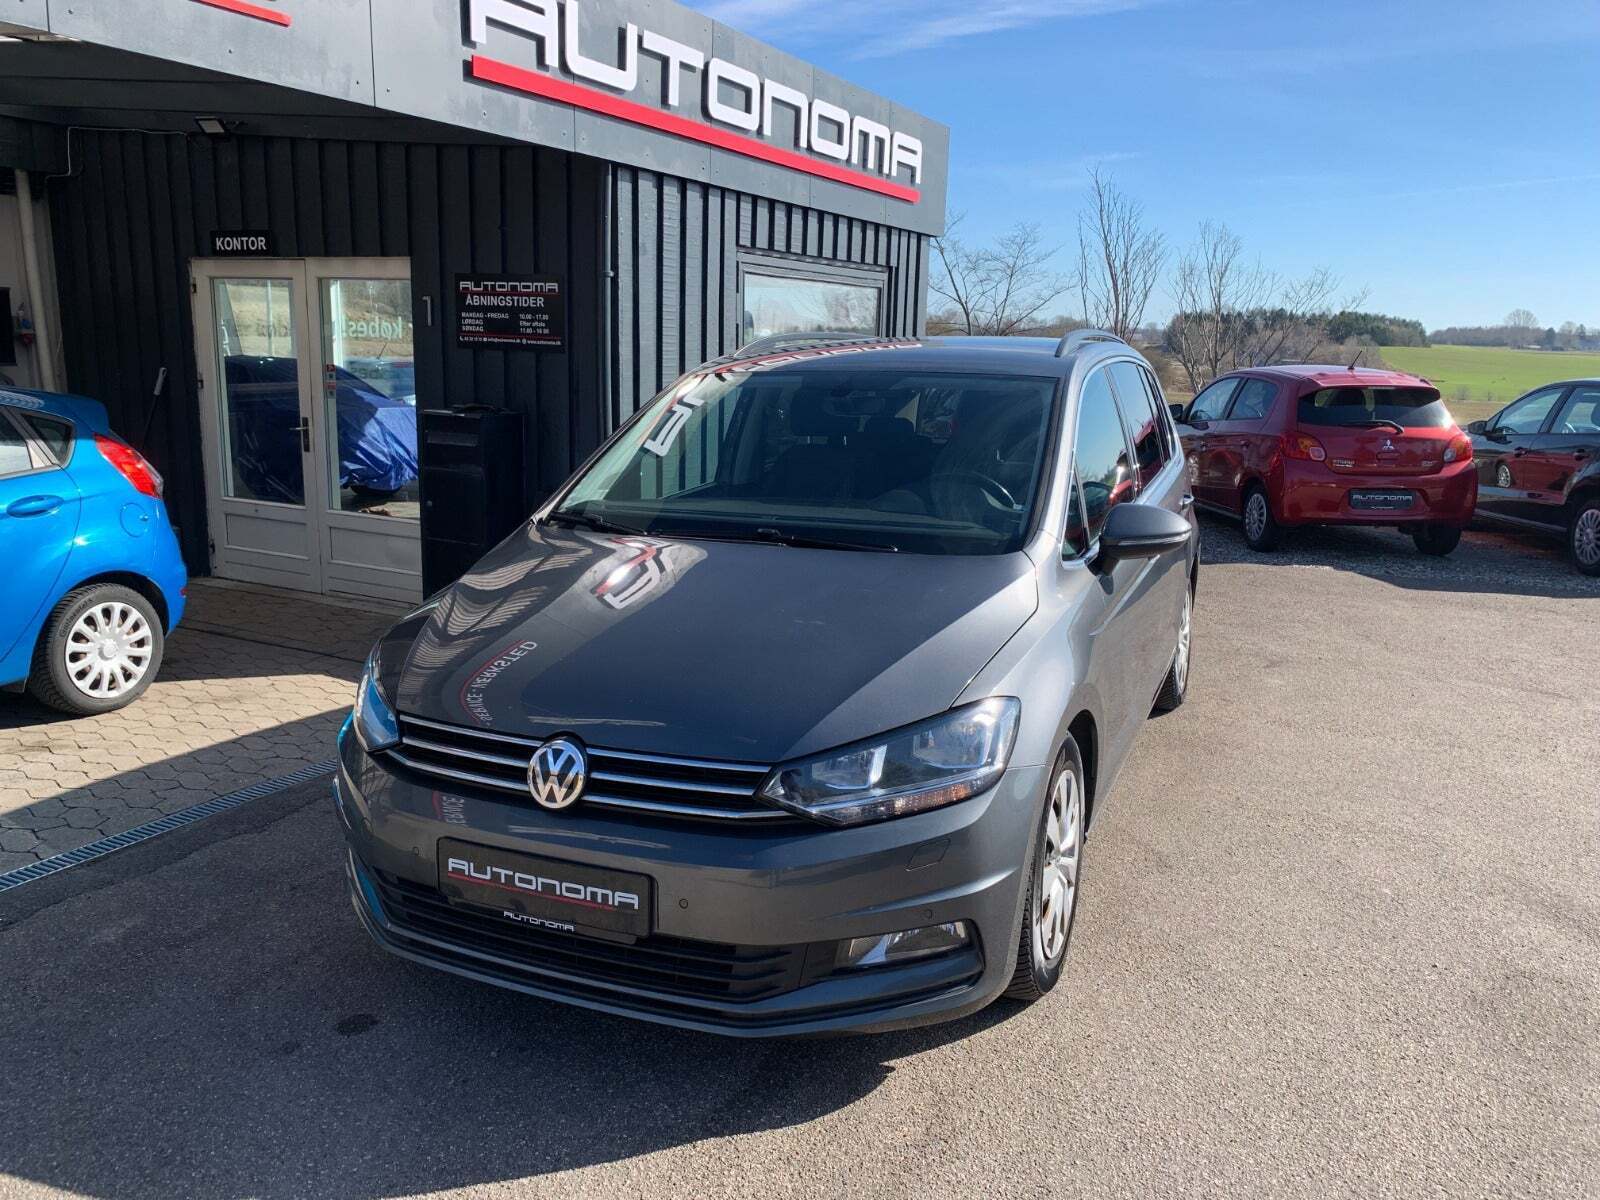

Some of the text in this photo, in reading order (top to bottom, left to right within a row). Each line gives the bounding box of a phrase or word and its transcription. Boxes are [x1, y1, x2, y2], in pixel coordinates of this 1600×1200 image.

[470, 0, 922, 184] AUTONOMA
[215, 236, 267, 250] KONTOR
[459, 281, 559, 293] AUTONOMA
[465, 293, 545, 307] ÅBNINGSTIDER
[448, 857, 640, 910] AUTONOMA
[503, 911, 576, 932] AUTONOMA
